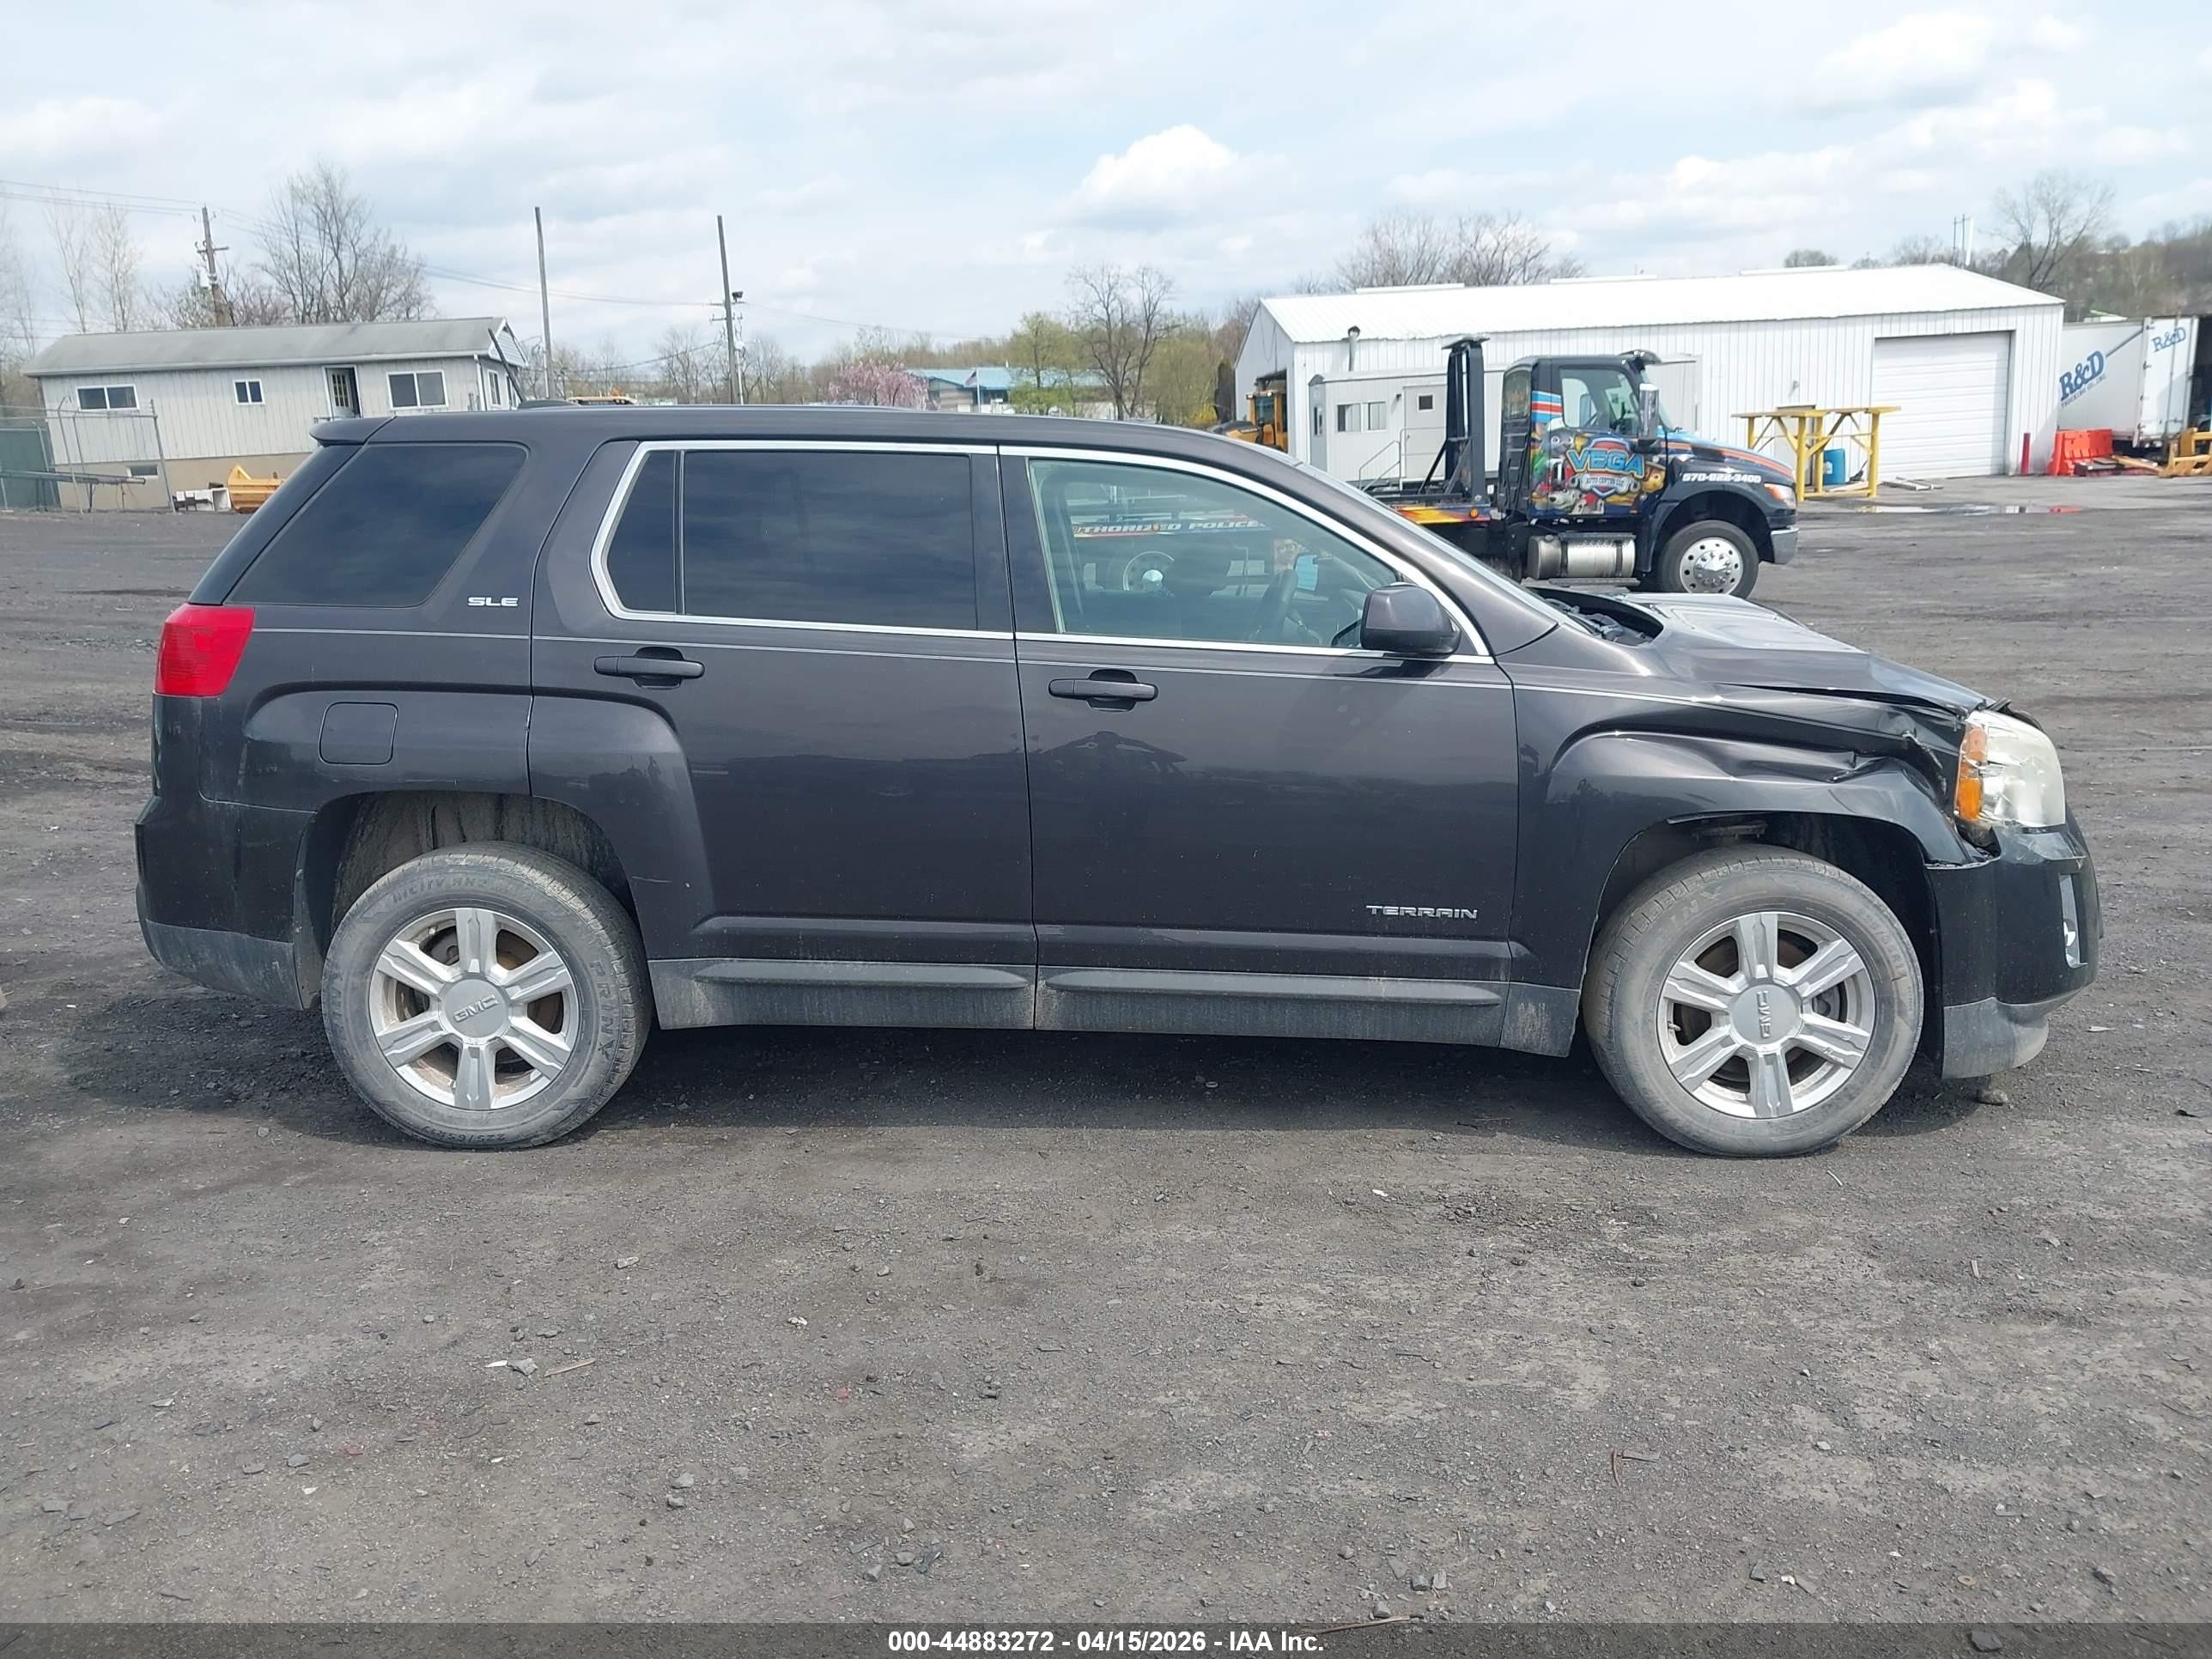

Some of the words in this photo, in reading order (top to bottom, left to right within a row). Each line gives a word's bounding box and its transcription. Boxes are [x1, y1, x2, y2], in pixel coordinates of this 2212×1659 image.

[2151, 327, 2186, 352] R&D
[2059, 350, 2104, 402] R&D
[1567, 448, 1644, 477] VEGA
[1074, 523, 1182, 532] UTHORIZED
[468, 597, 519, 606] SLE
[1366, 905, 1478, 919] TERRAIN
[453, 994, 499, 1023] GMC
[1757, 990, 1771, 1038] GMC
